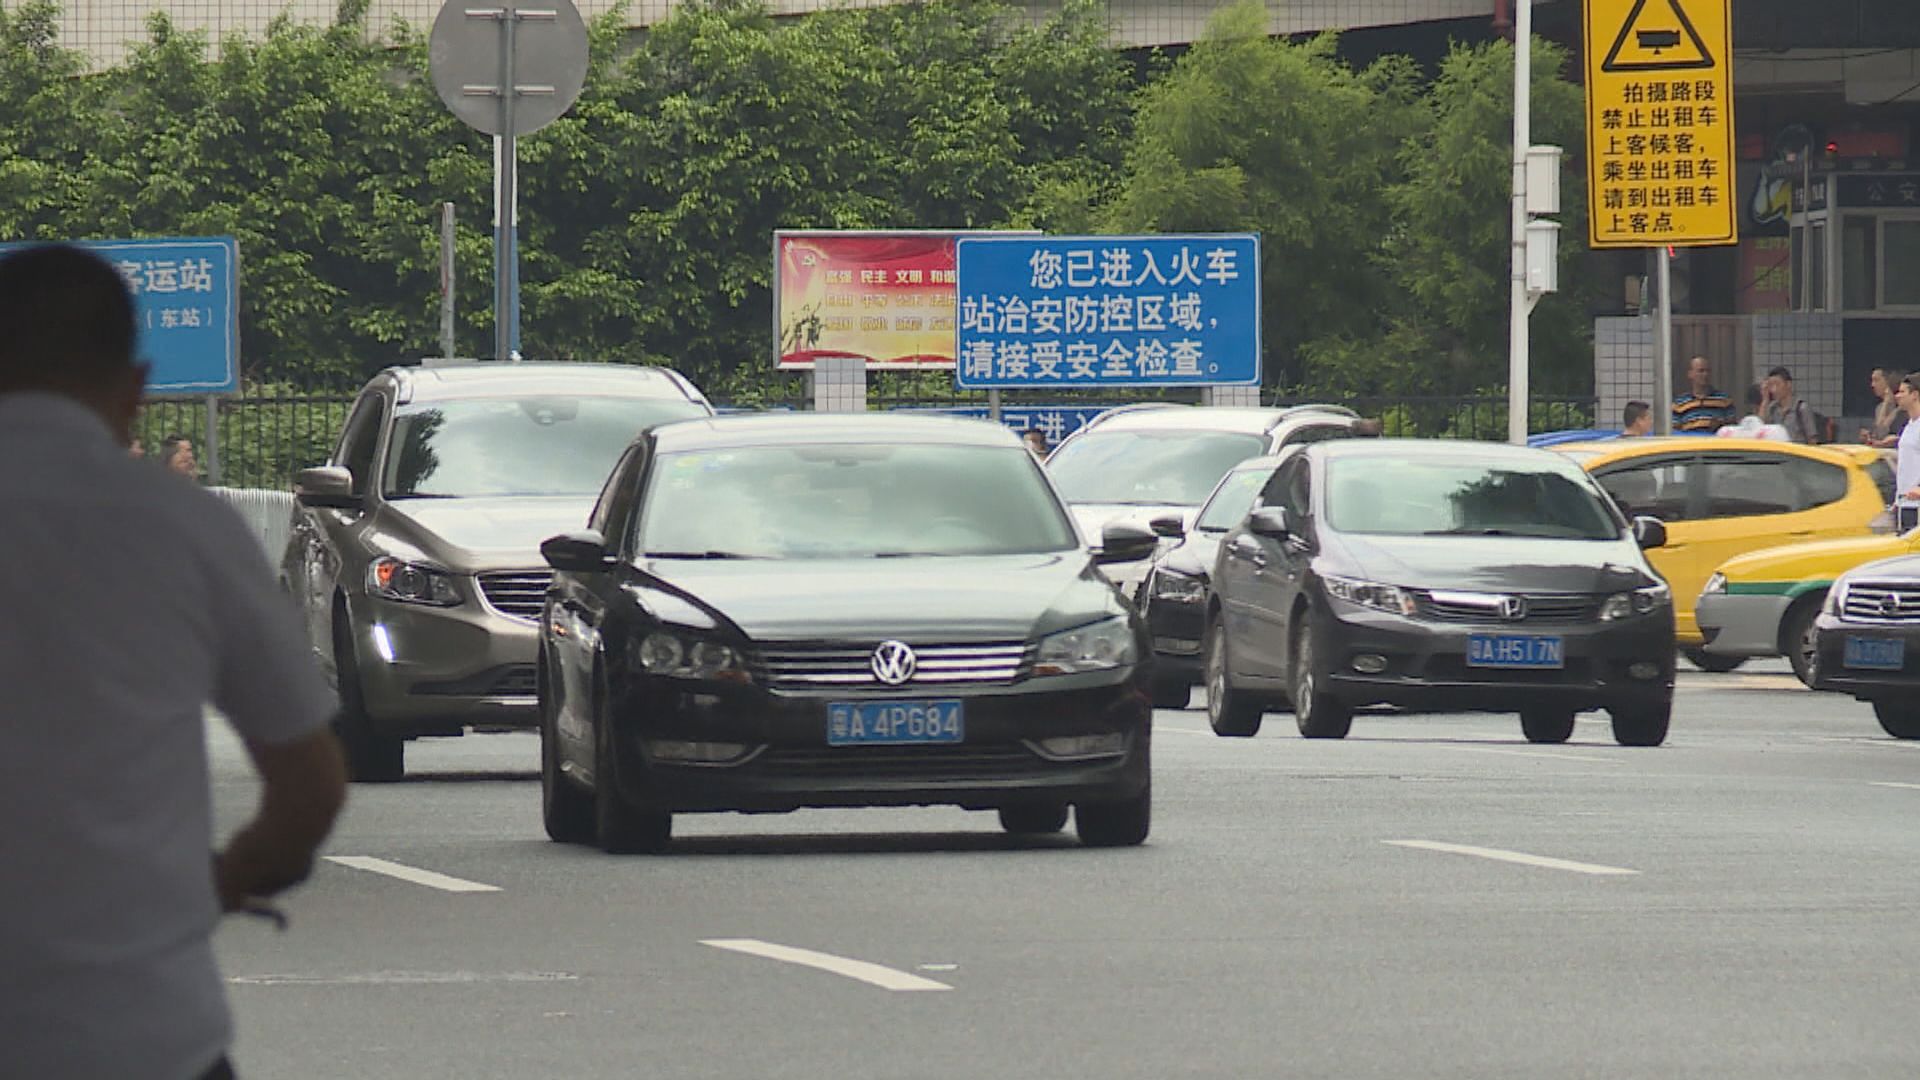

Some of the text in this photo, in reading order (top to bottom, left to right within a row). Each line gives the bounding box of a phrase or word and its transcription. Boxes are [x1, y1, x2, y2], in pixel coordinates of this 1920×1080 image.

[1624, 80, 1716, 103] 拍摄路段
[1602, 106, 1718, 130] 禁止出租车
[1603, 133, 1705, 156] 上客候客，
[1603, 159, 1718, 182] 乘坐出租车
[1604, 185, 1719, 209] 请到出租车
[1606, 212, 1687, 234] 上客点。
[860, 270, 888, 284] 民主
[895, 270, 922, 284] 文明
[1029, 247, 1239, 290] 您已进入火车
[962, 296, 1219, 335] 站治安防控区域，
[962, 339, 1220, 380] 请接受安全检查。
